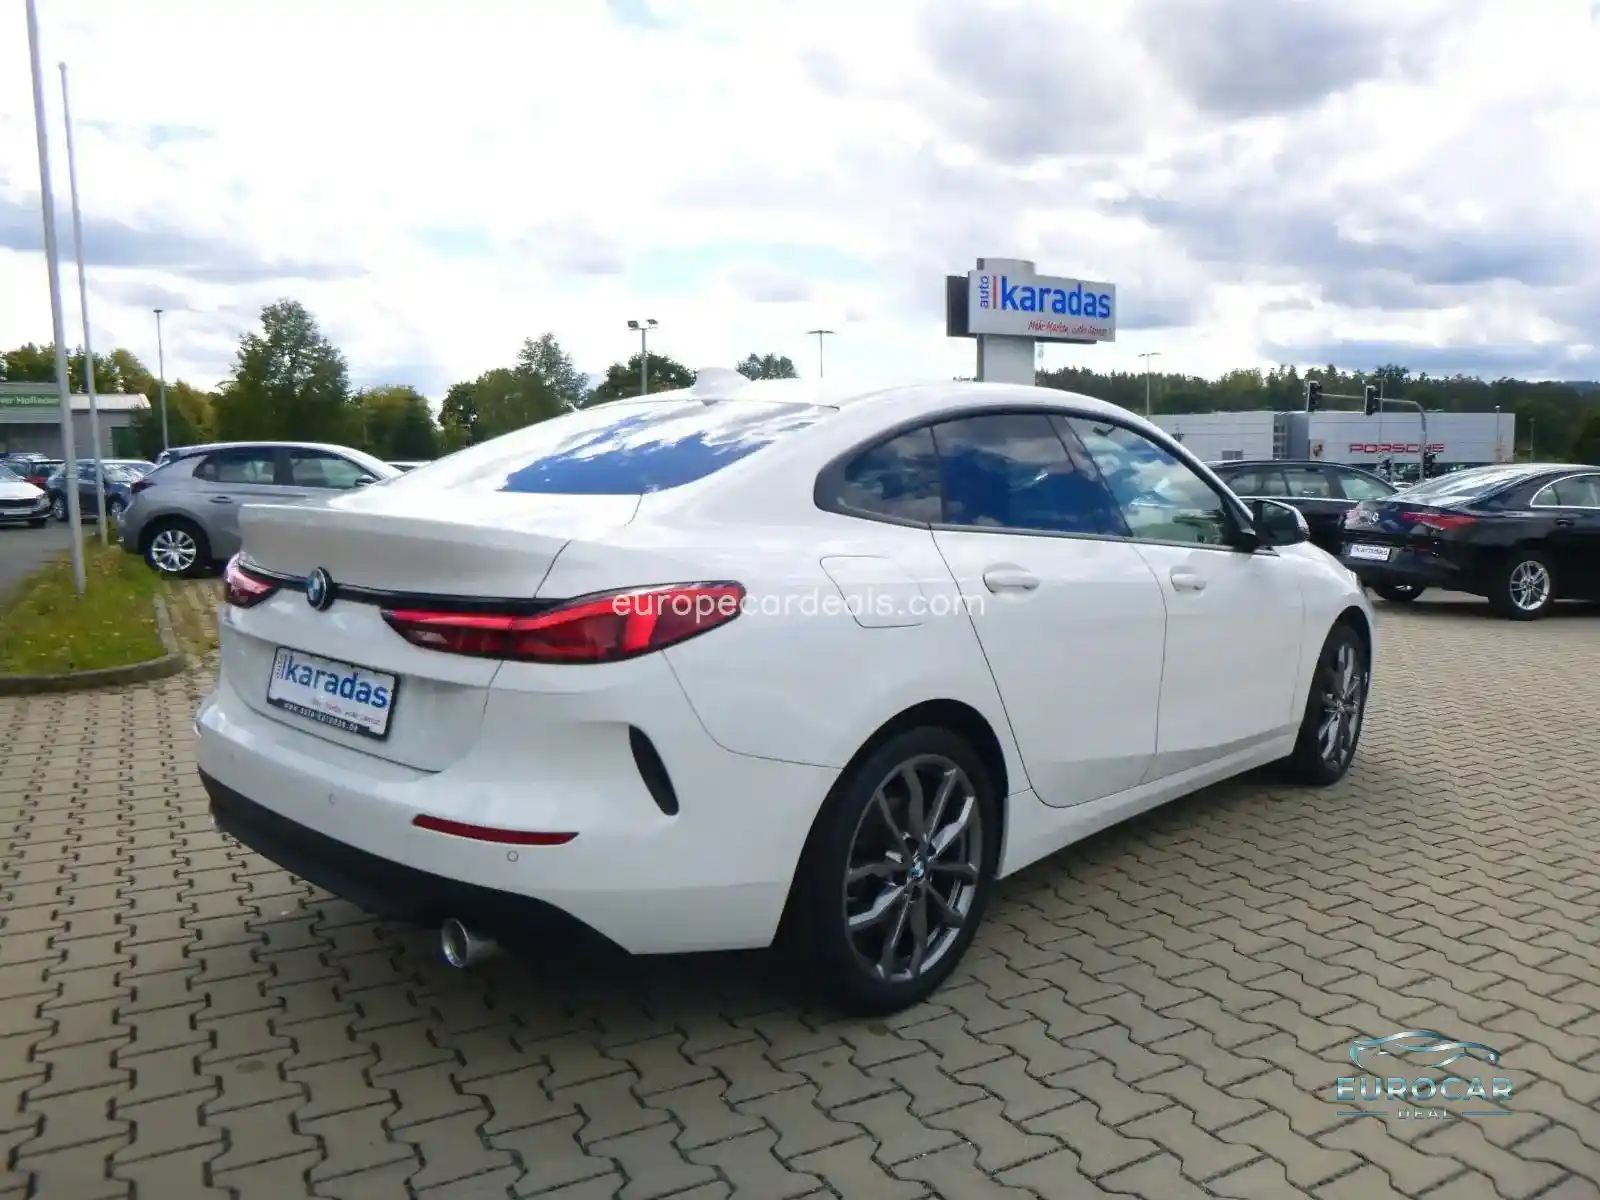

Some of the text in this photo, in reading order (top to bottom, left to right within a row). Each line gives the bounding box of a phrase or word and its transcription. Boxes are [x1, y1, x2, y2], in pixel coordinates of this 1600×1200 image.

[980, 275, 990, 309] auto
[1001, 276, 1111, 319] karadas
[285, 654, 389, 709] karadas
